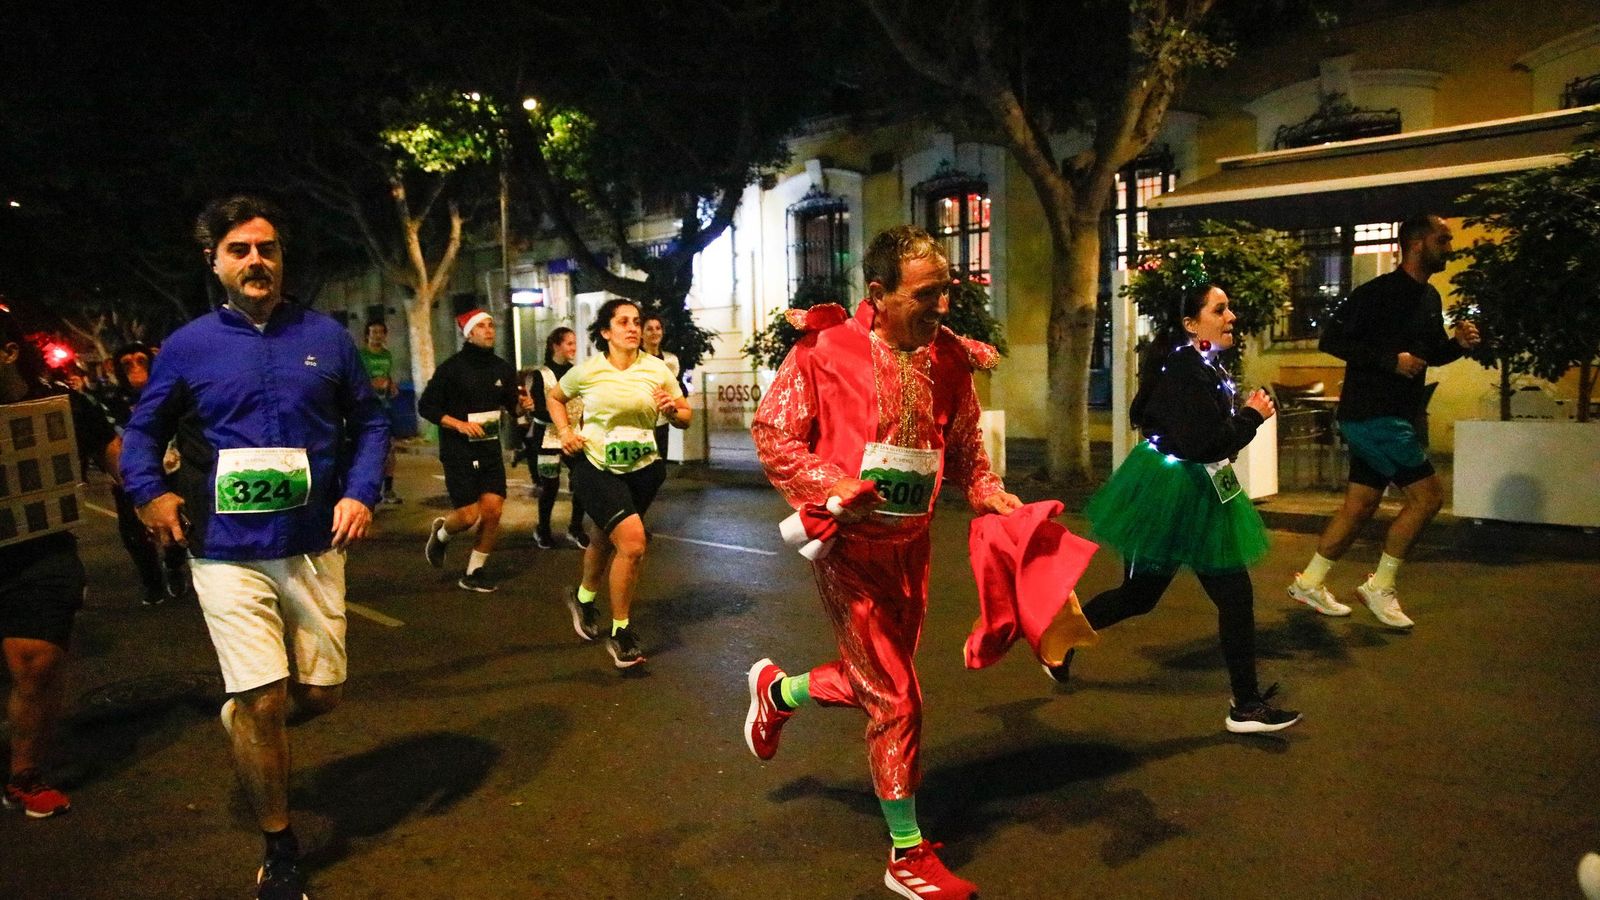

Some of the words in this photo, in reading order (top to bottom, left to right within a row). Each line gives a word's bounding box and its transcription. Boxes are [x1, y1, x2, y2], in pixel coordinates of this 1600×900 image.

[718, 384, 761, 402] ROSSO
[232, 480, 292, 503] 324
[874, 480, 924, 505] 500
